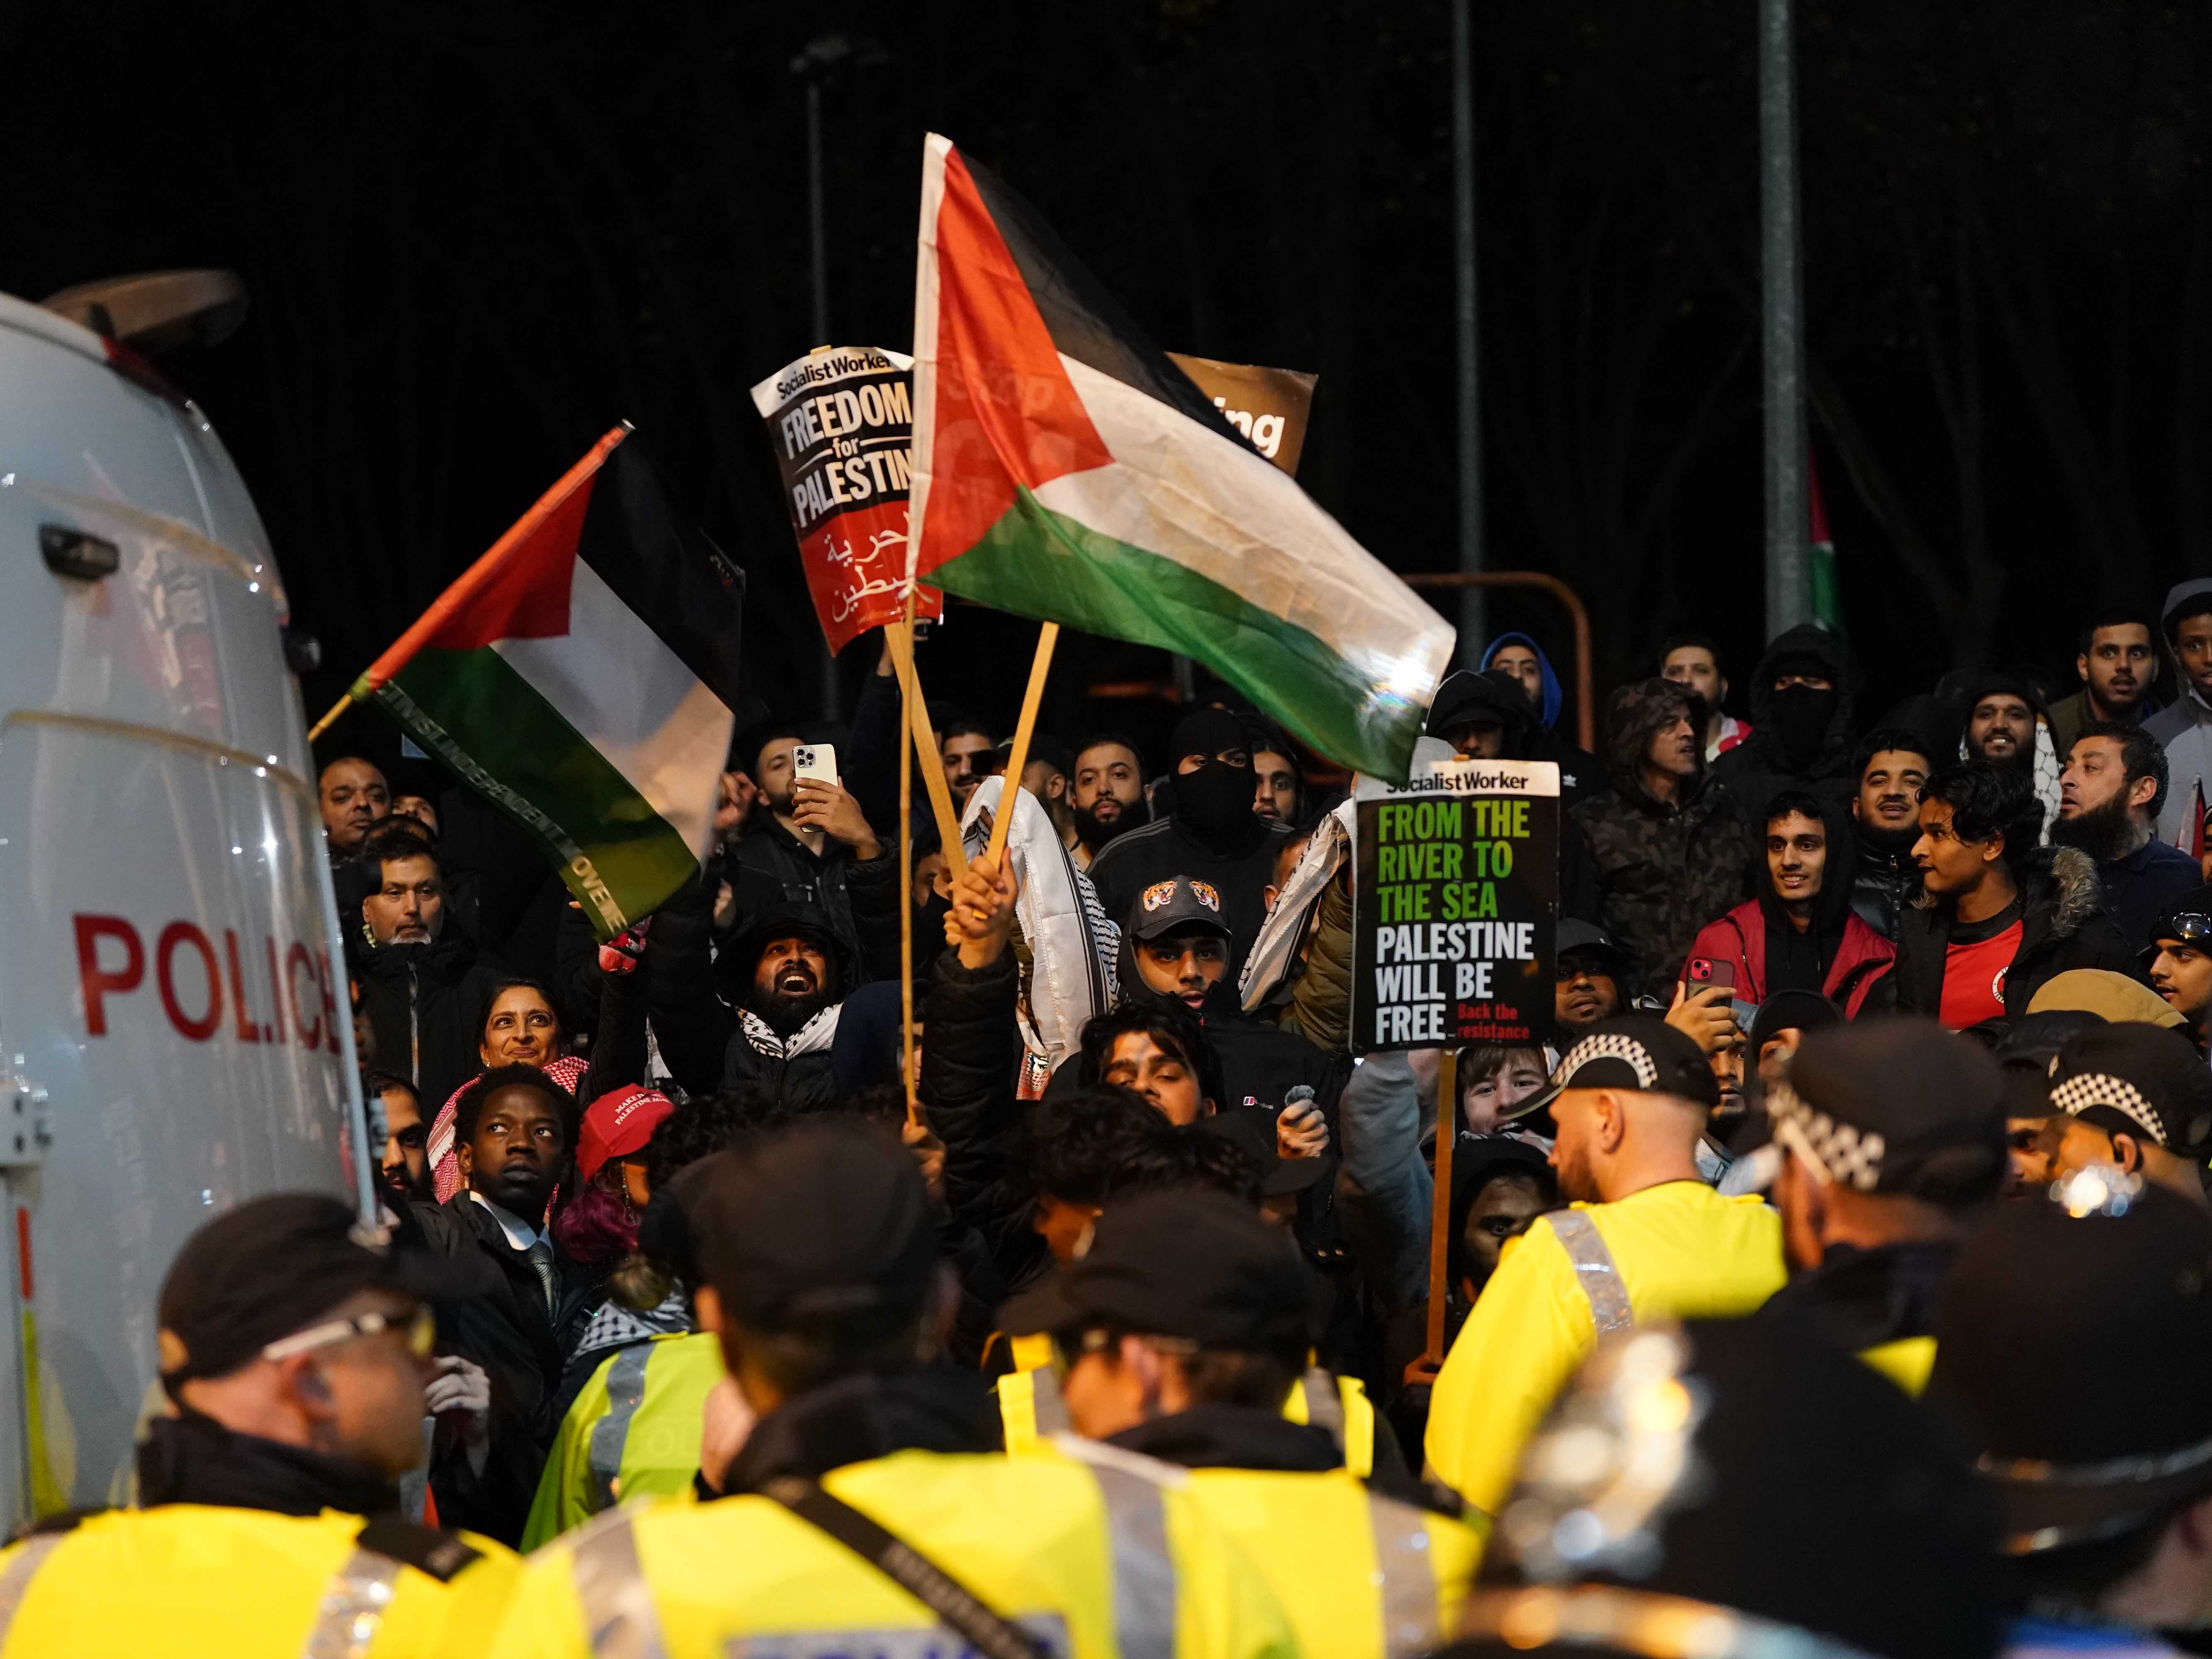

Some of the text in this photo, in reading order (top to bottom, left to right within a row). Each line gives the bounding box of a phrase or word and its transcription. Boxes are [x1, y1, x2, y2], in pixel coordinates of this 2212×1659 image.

[777, 362, 832, 400] Socialist
[781, 381, 912, 460] FREEDOM
[832, 437, 859, 458] for
[792, 448, 912, 528] PALESTIN
[1386, 771, 1529, 793] cialist Worker
[1378, 800, 1530, 843] FROM THE
[1378, 840, 1513, 883] RIVER TO
[1376, 882, 1498, 923] THE SEA
[1376, 922, 1535, 964] PALESTINE
[72, 912, 342, 1057] POLICE
[1375, 962, 1493, 1004] WILL BE
[1375, 1004, 1447, 1045] FREE
[1457, 1022, 1530, 1039] resistance
[1458, 1002, 1518, 1021] Back the
[614, 1097, 651, 1125] PALESTINE
[615, 1095, 638, 1114] MAKE
